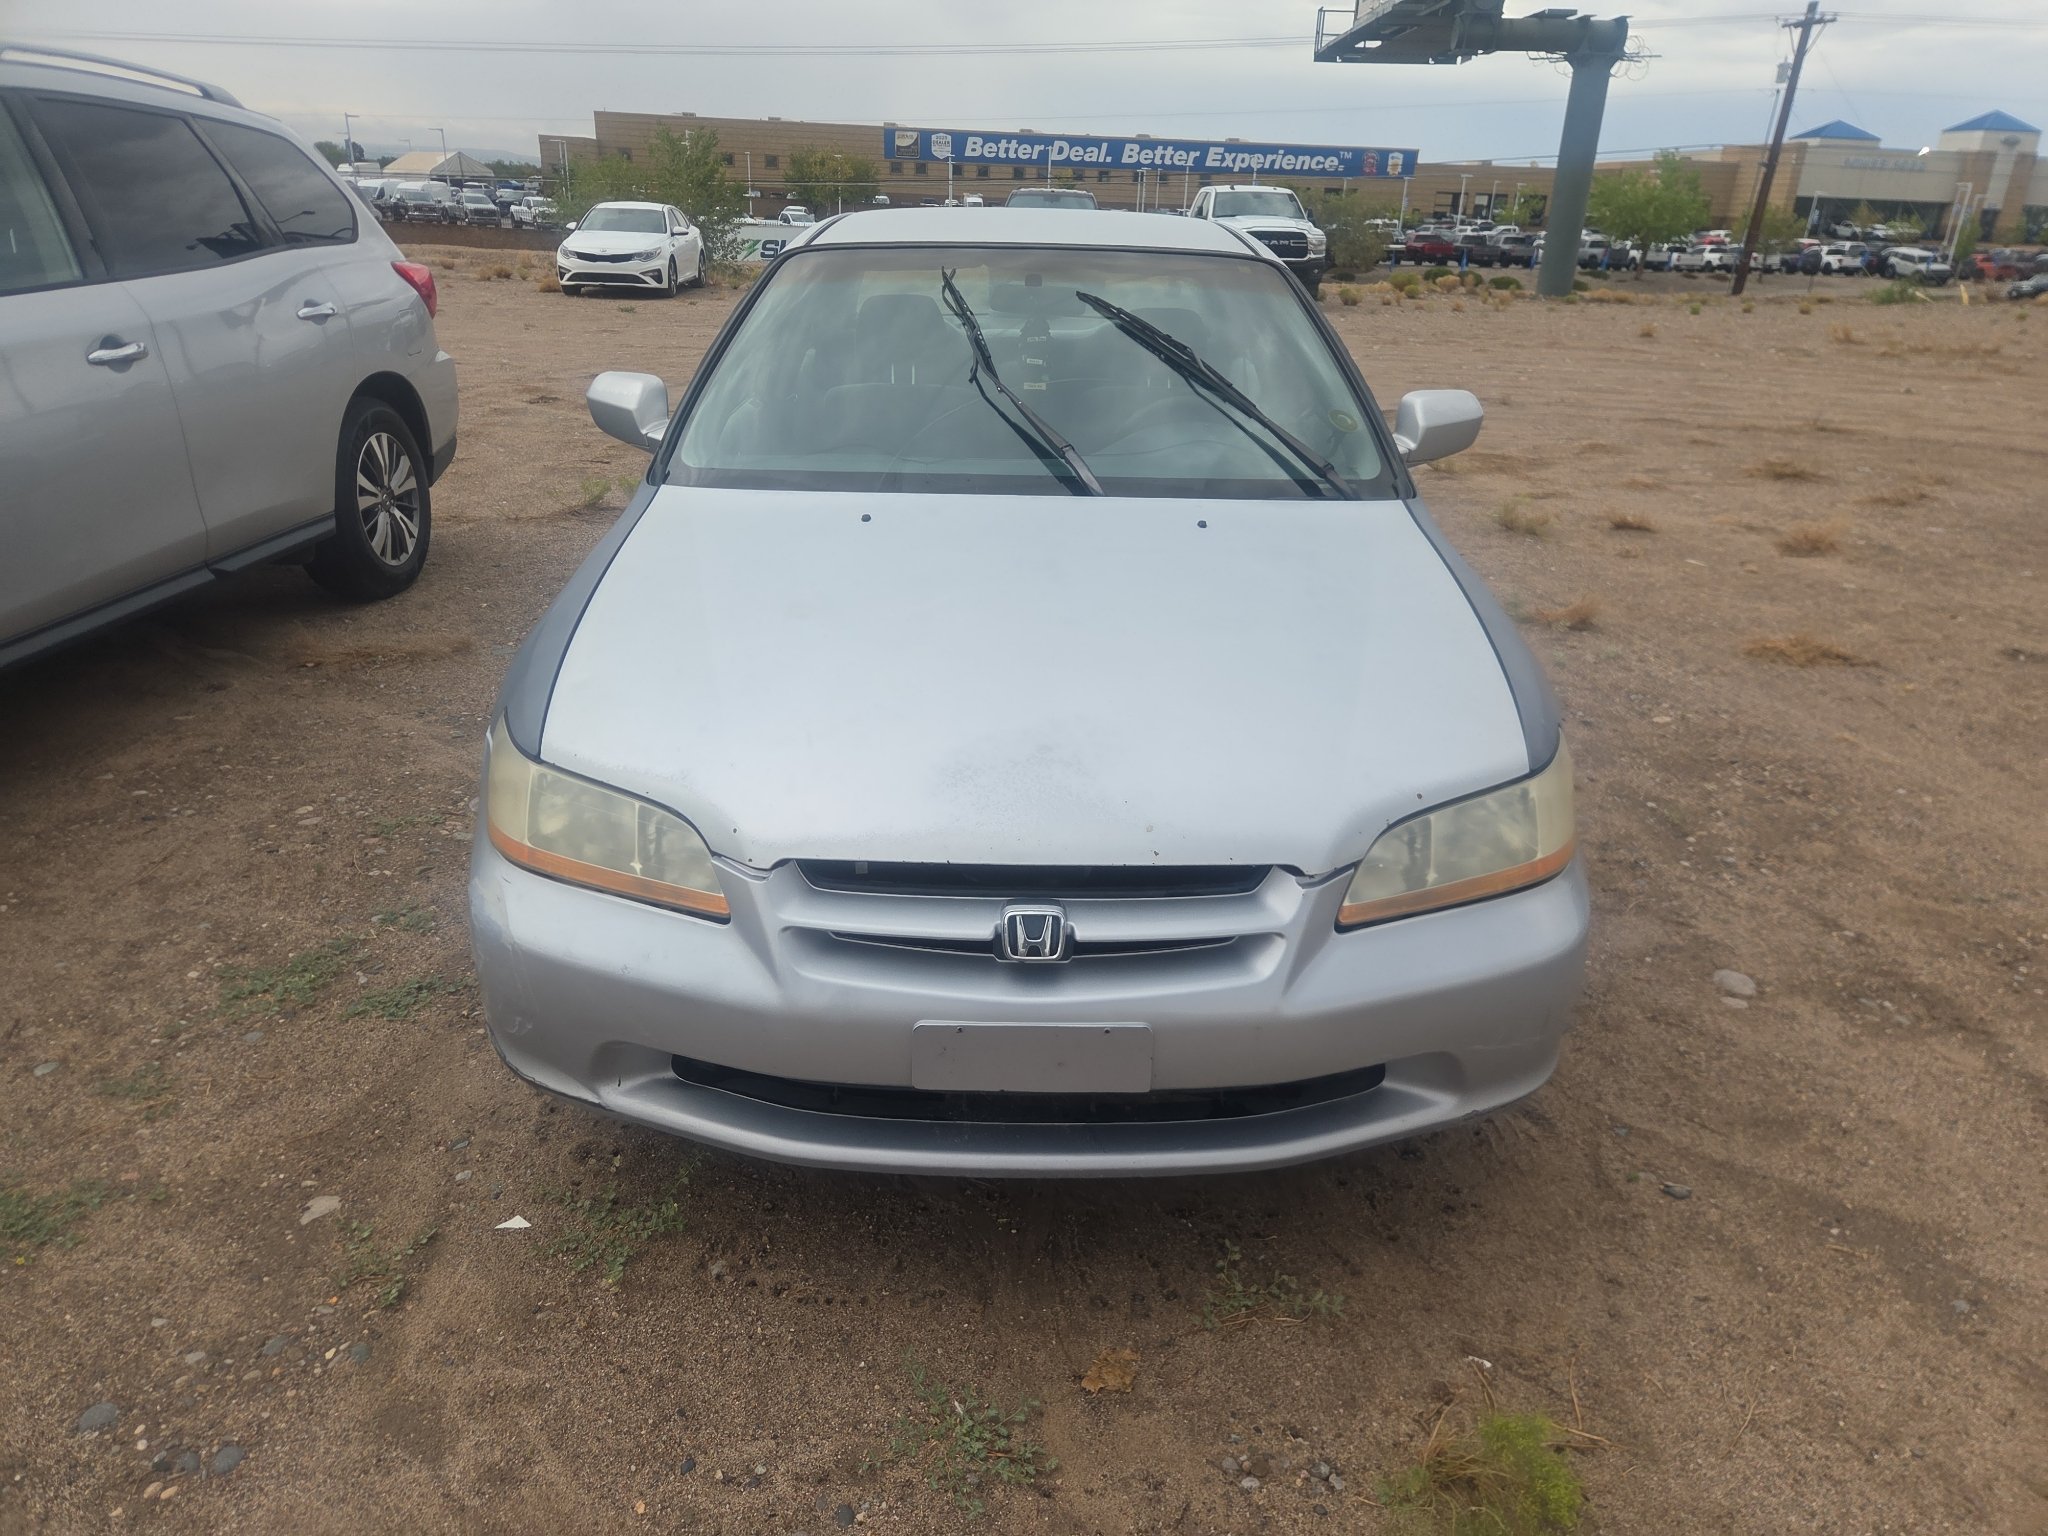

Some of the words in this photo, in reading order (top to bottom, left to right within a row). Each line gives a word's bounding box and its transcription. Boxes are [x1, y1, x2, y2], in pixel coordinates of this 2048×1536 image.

[964, 136, 1045, 160] Better
[1050, 140, 1113, 163] Deal.
[1121, 143, 1200, 166] Better
[1205, 147, 1345, 172] Experience.
